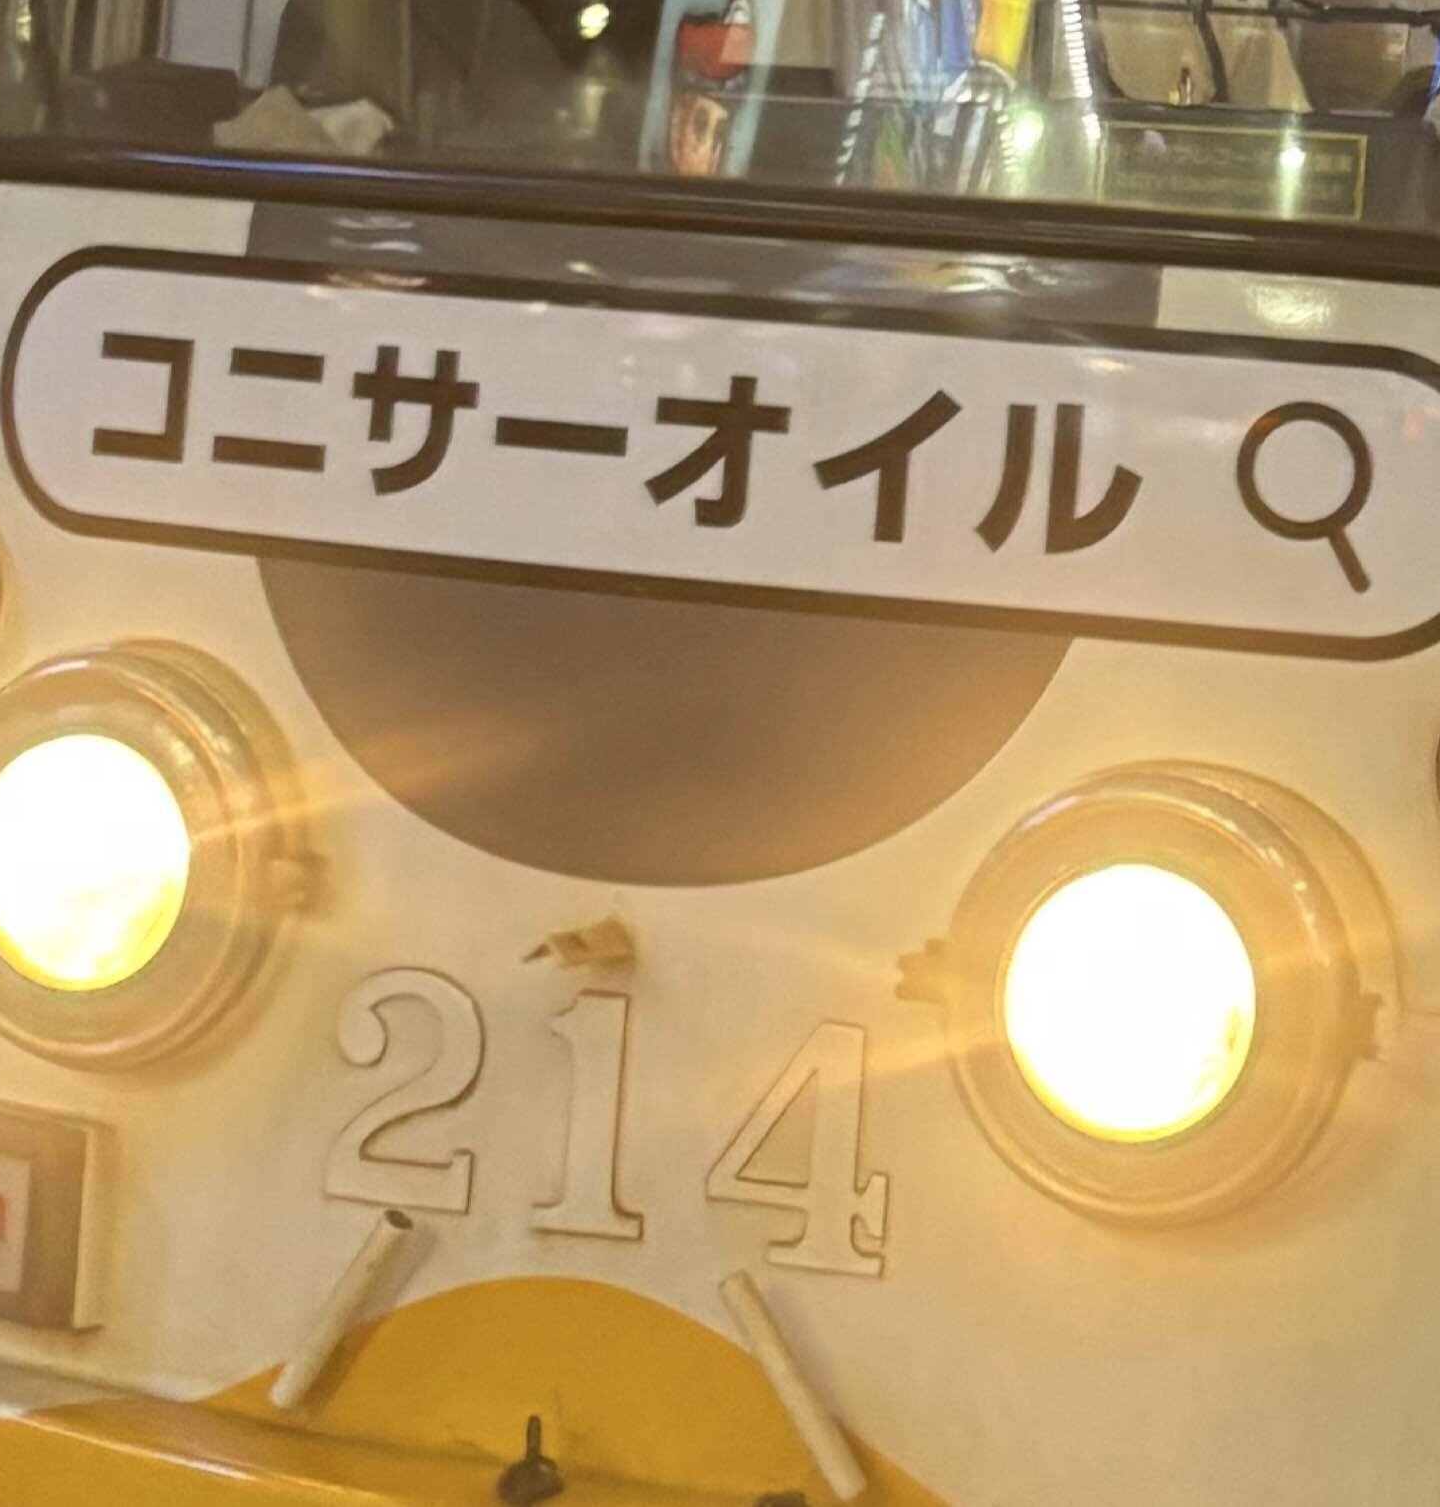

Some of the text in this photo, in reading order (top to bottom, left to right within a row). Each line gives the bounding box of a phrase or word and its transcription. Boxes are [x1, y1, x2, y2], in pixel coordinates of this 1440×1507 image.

[91, 330, 1144, 555] コニサーオイル
[323, 965, 891, 1279] 214
